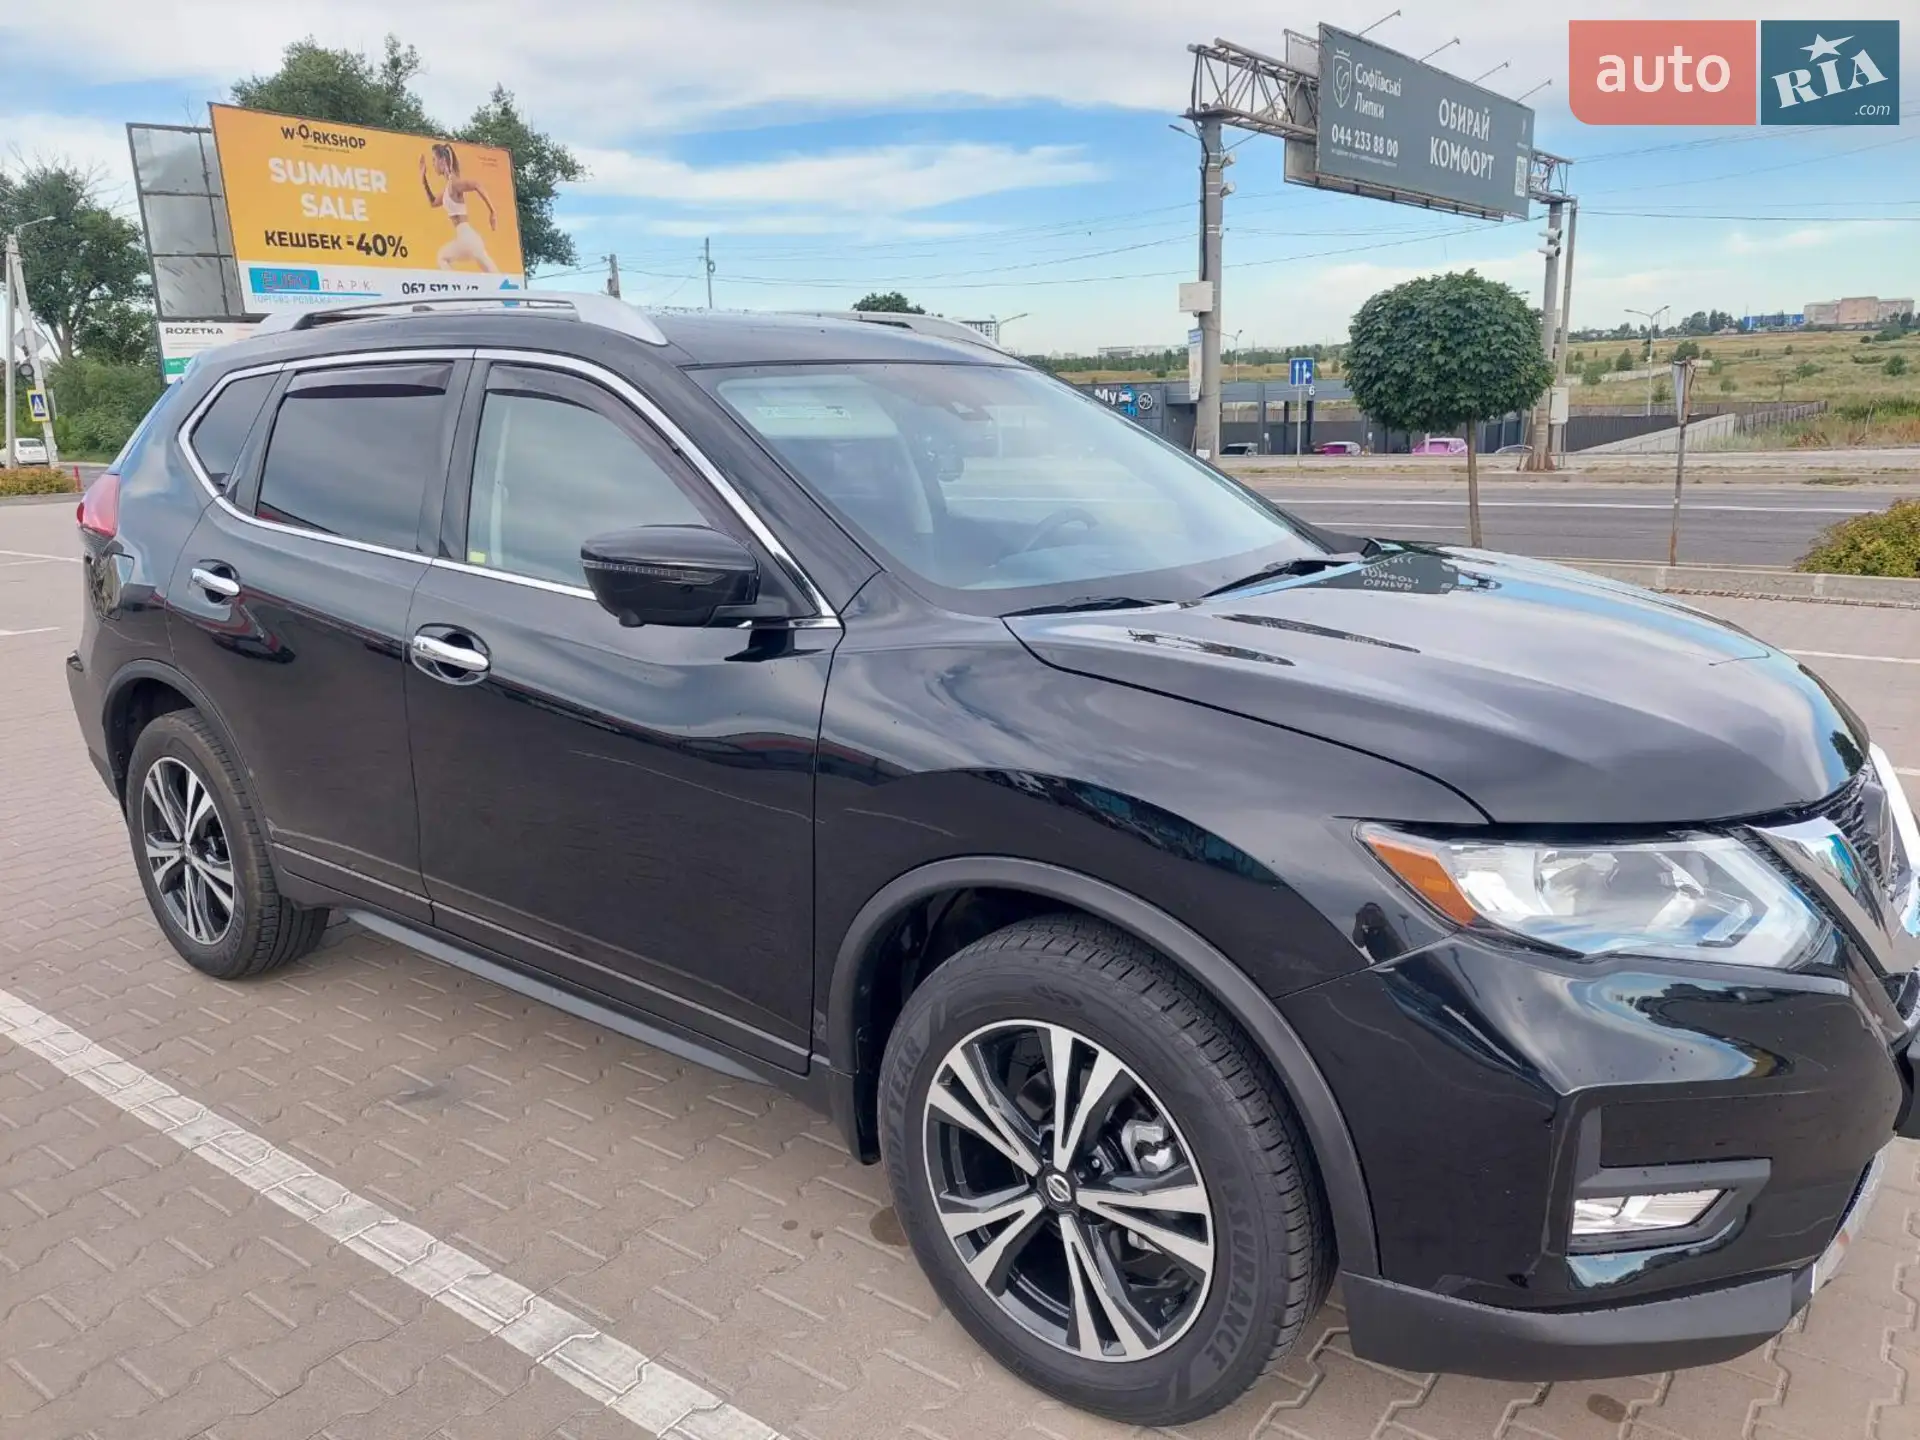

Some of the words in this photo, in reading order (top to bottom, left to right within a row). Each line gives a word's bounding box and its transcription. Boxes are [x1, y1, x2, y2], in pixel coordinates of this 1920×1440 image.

[1354, 91, 1385, 119] Липки
[1439, 98, 1490, 142] ОБИРАЙ
[1331, 123, 1352, 147] 044
[1354, 130, 1371, 151] 233
[1373, 135, 1385, 154] 88
[1386, 138, 1399, 158] 00
[1430, 136, 1495, 180] КОМФОРТ
[268, 157, 388, 193] SUMMER
[301, 192, 370, 222] SALE
[264, 230, 343, 250] КЕШБЕК
[346, 233, 409, 258] -40%
[401, 282, 426, 295] 067
[165, 327, 224, 335] ROZETKA
[1095, 388, 1117, 405] My
[1308, 385, 1316, 396] 6
